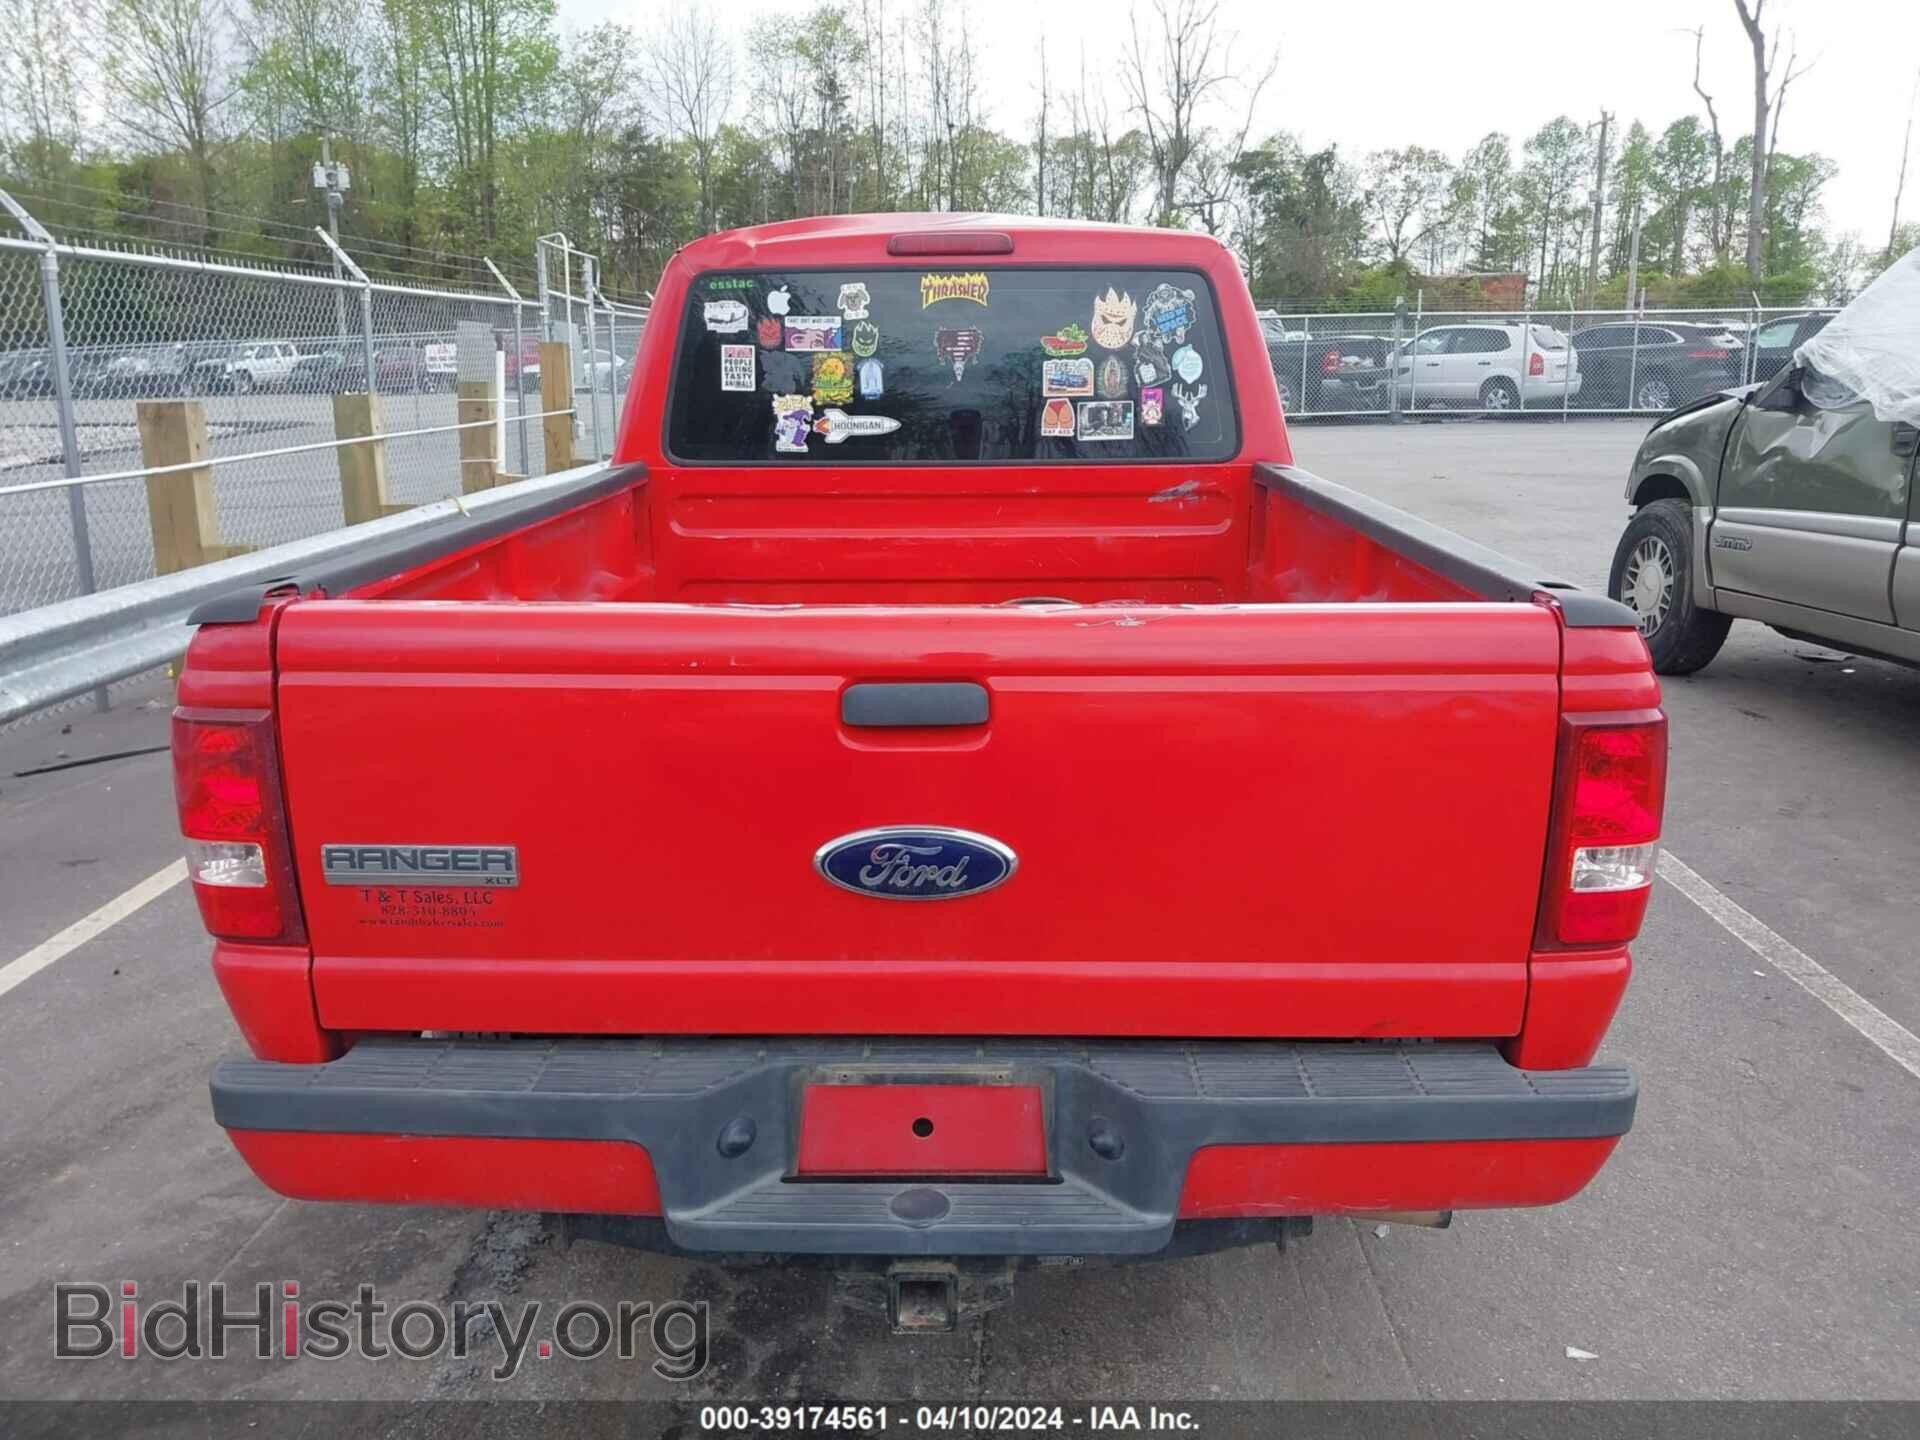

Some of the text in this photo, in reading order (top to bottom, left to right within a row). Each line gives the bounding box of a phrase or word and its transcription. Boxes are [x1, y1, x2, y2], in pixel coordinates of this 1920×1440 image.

[709, 279, 753, 290] esstac
[921, 273, 989, 308] THRASHER
[834, 421, 882, 431] HOONIGAN
[324, 847, 513, 871] RANGER
[859, 843, 970, 887] Ford
[485, 877, 515, 885] XLT
[360, 890, 369, 902] T
[378, 890, 391, 902] &
[398, 890, 407, 902] T
[464, 890, 493, 904] LLC
